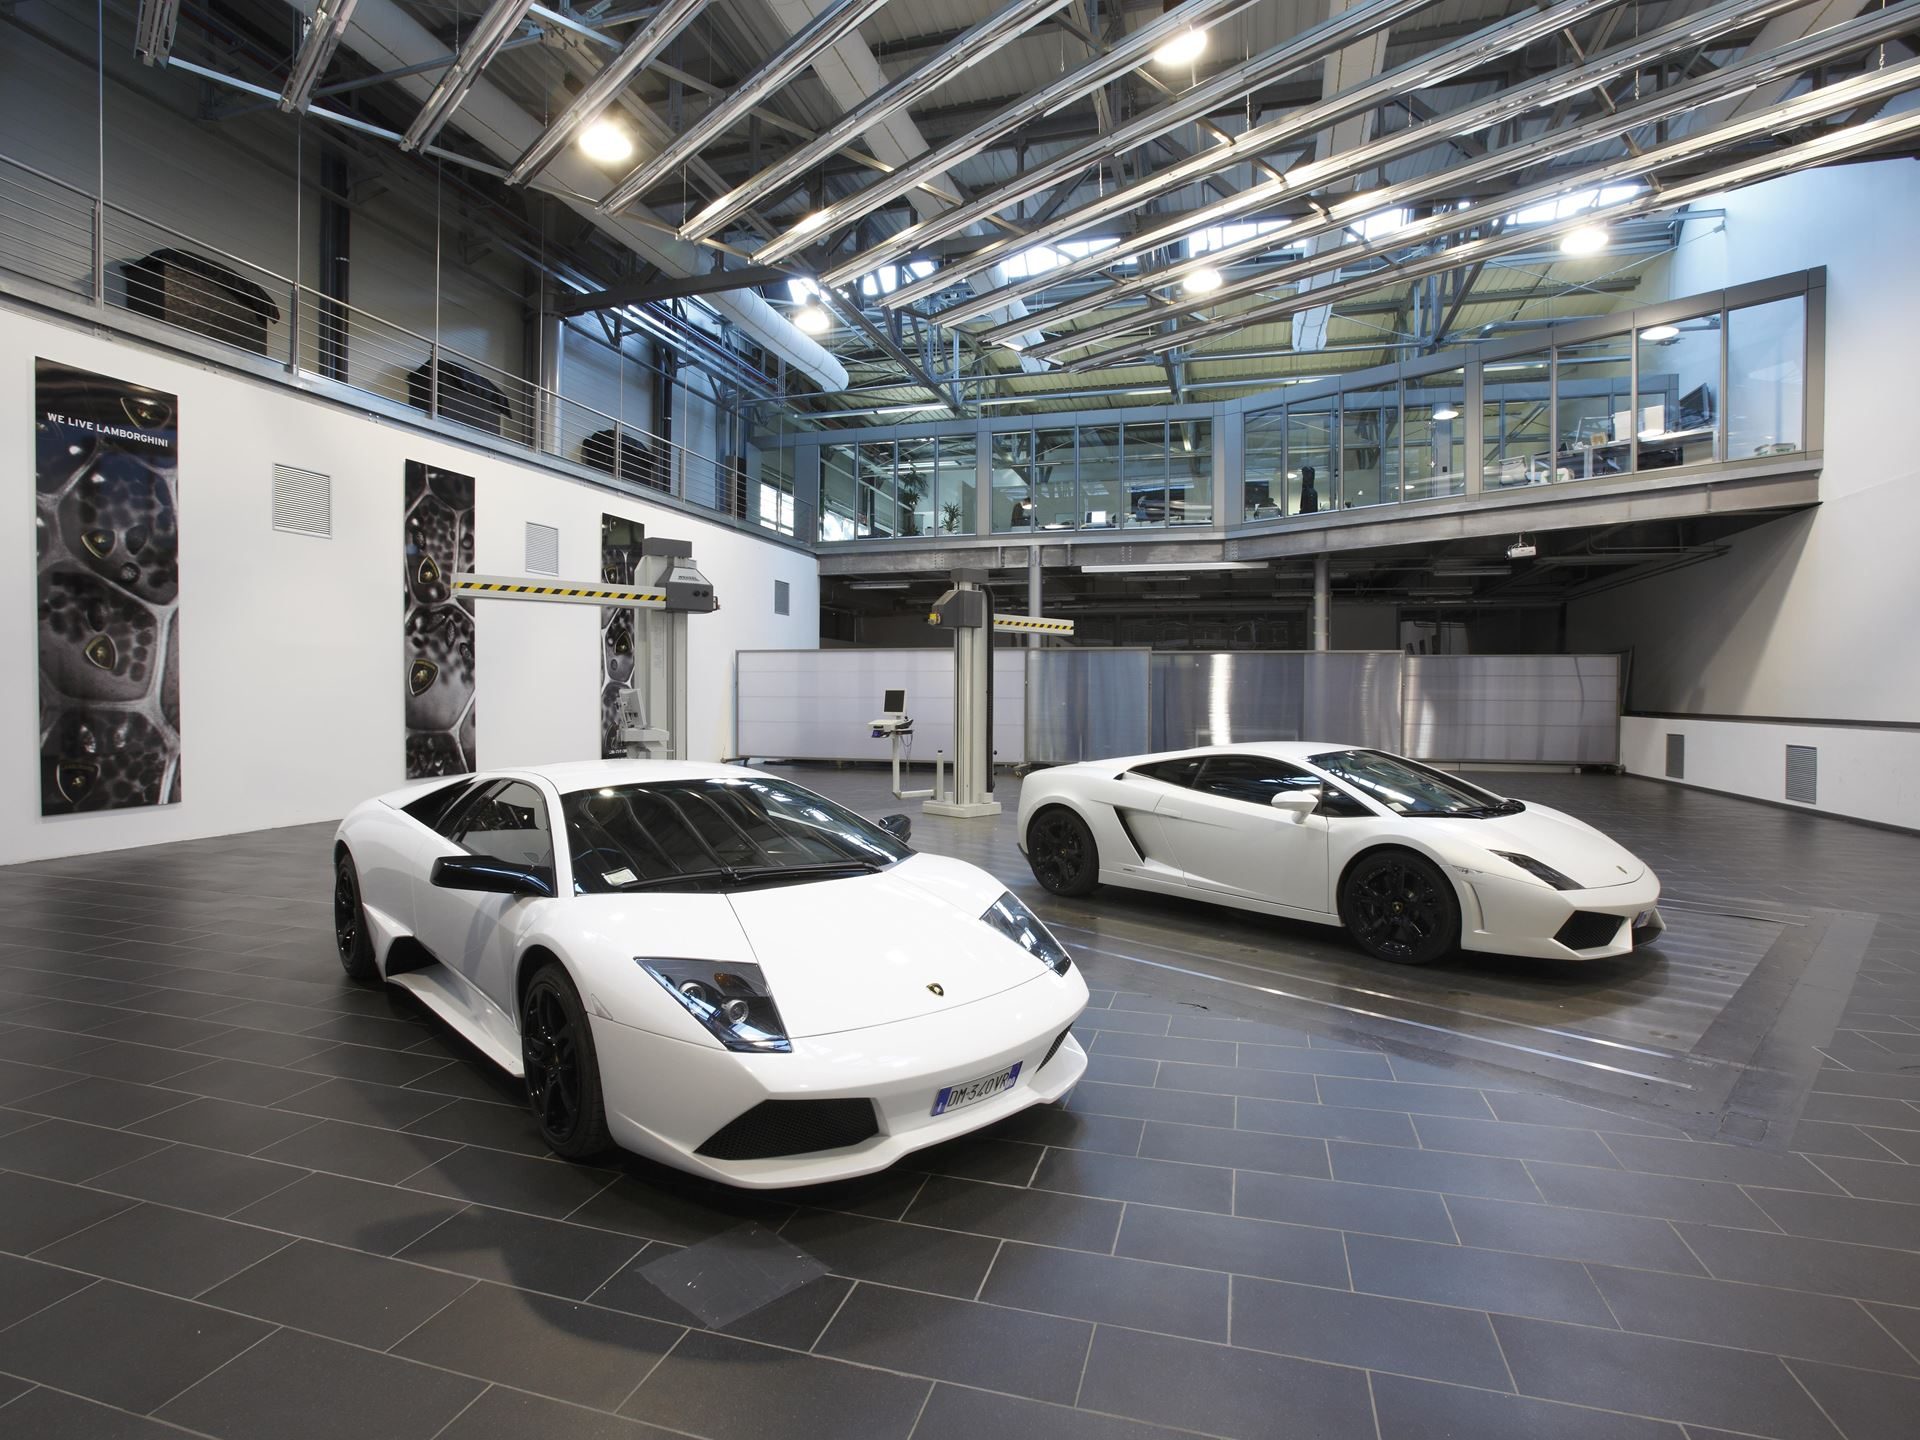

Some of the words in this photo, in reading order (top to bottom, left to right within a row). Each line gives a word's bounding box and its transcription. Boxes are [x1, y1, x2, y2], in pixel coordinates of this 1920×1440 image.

[47, 412, 65, 424] WE
[68, 417, 94, 431] LIVE
[96, 423, 168, 448] LAMBORGHINI
